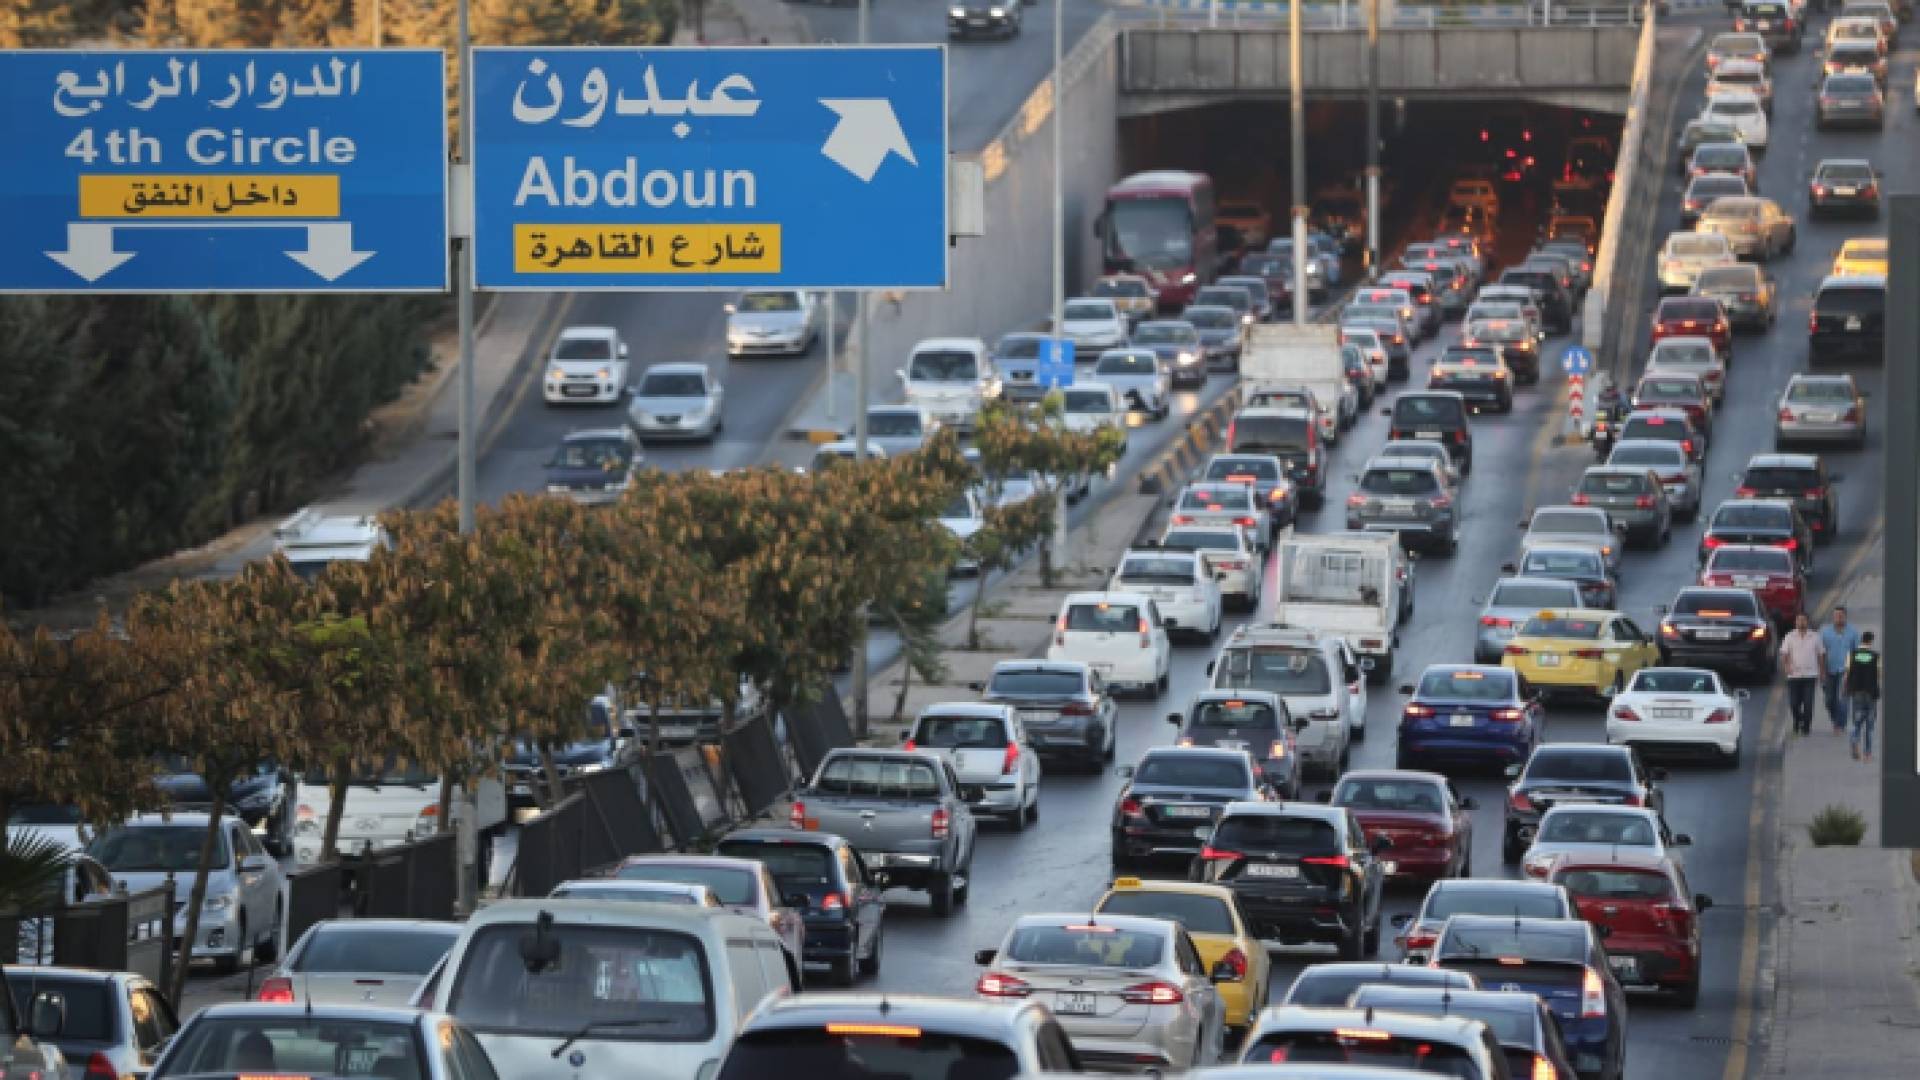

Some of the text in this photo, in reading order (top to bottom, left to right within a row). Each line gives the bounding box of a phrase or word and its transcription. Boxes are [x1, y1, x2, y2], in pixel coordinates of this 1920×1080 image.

[54, 57, 361, 116] الدوار الرابع
[513, 59, 761, 138] عبدون
[65, 129, 355, 164] 4th Circle
[124, 183, 297, 213] داخل النفق
[515, 157, 756, 208] Abdoun
[532, 232, 764, 267] شارع القاهرة
